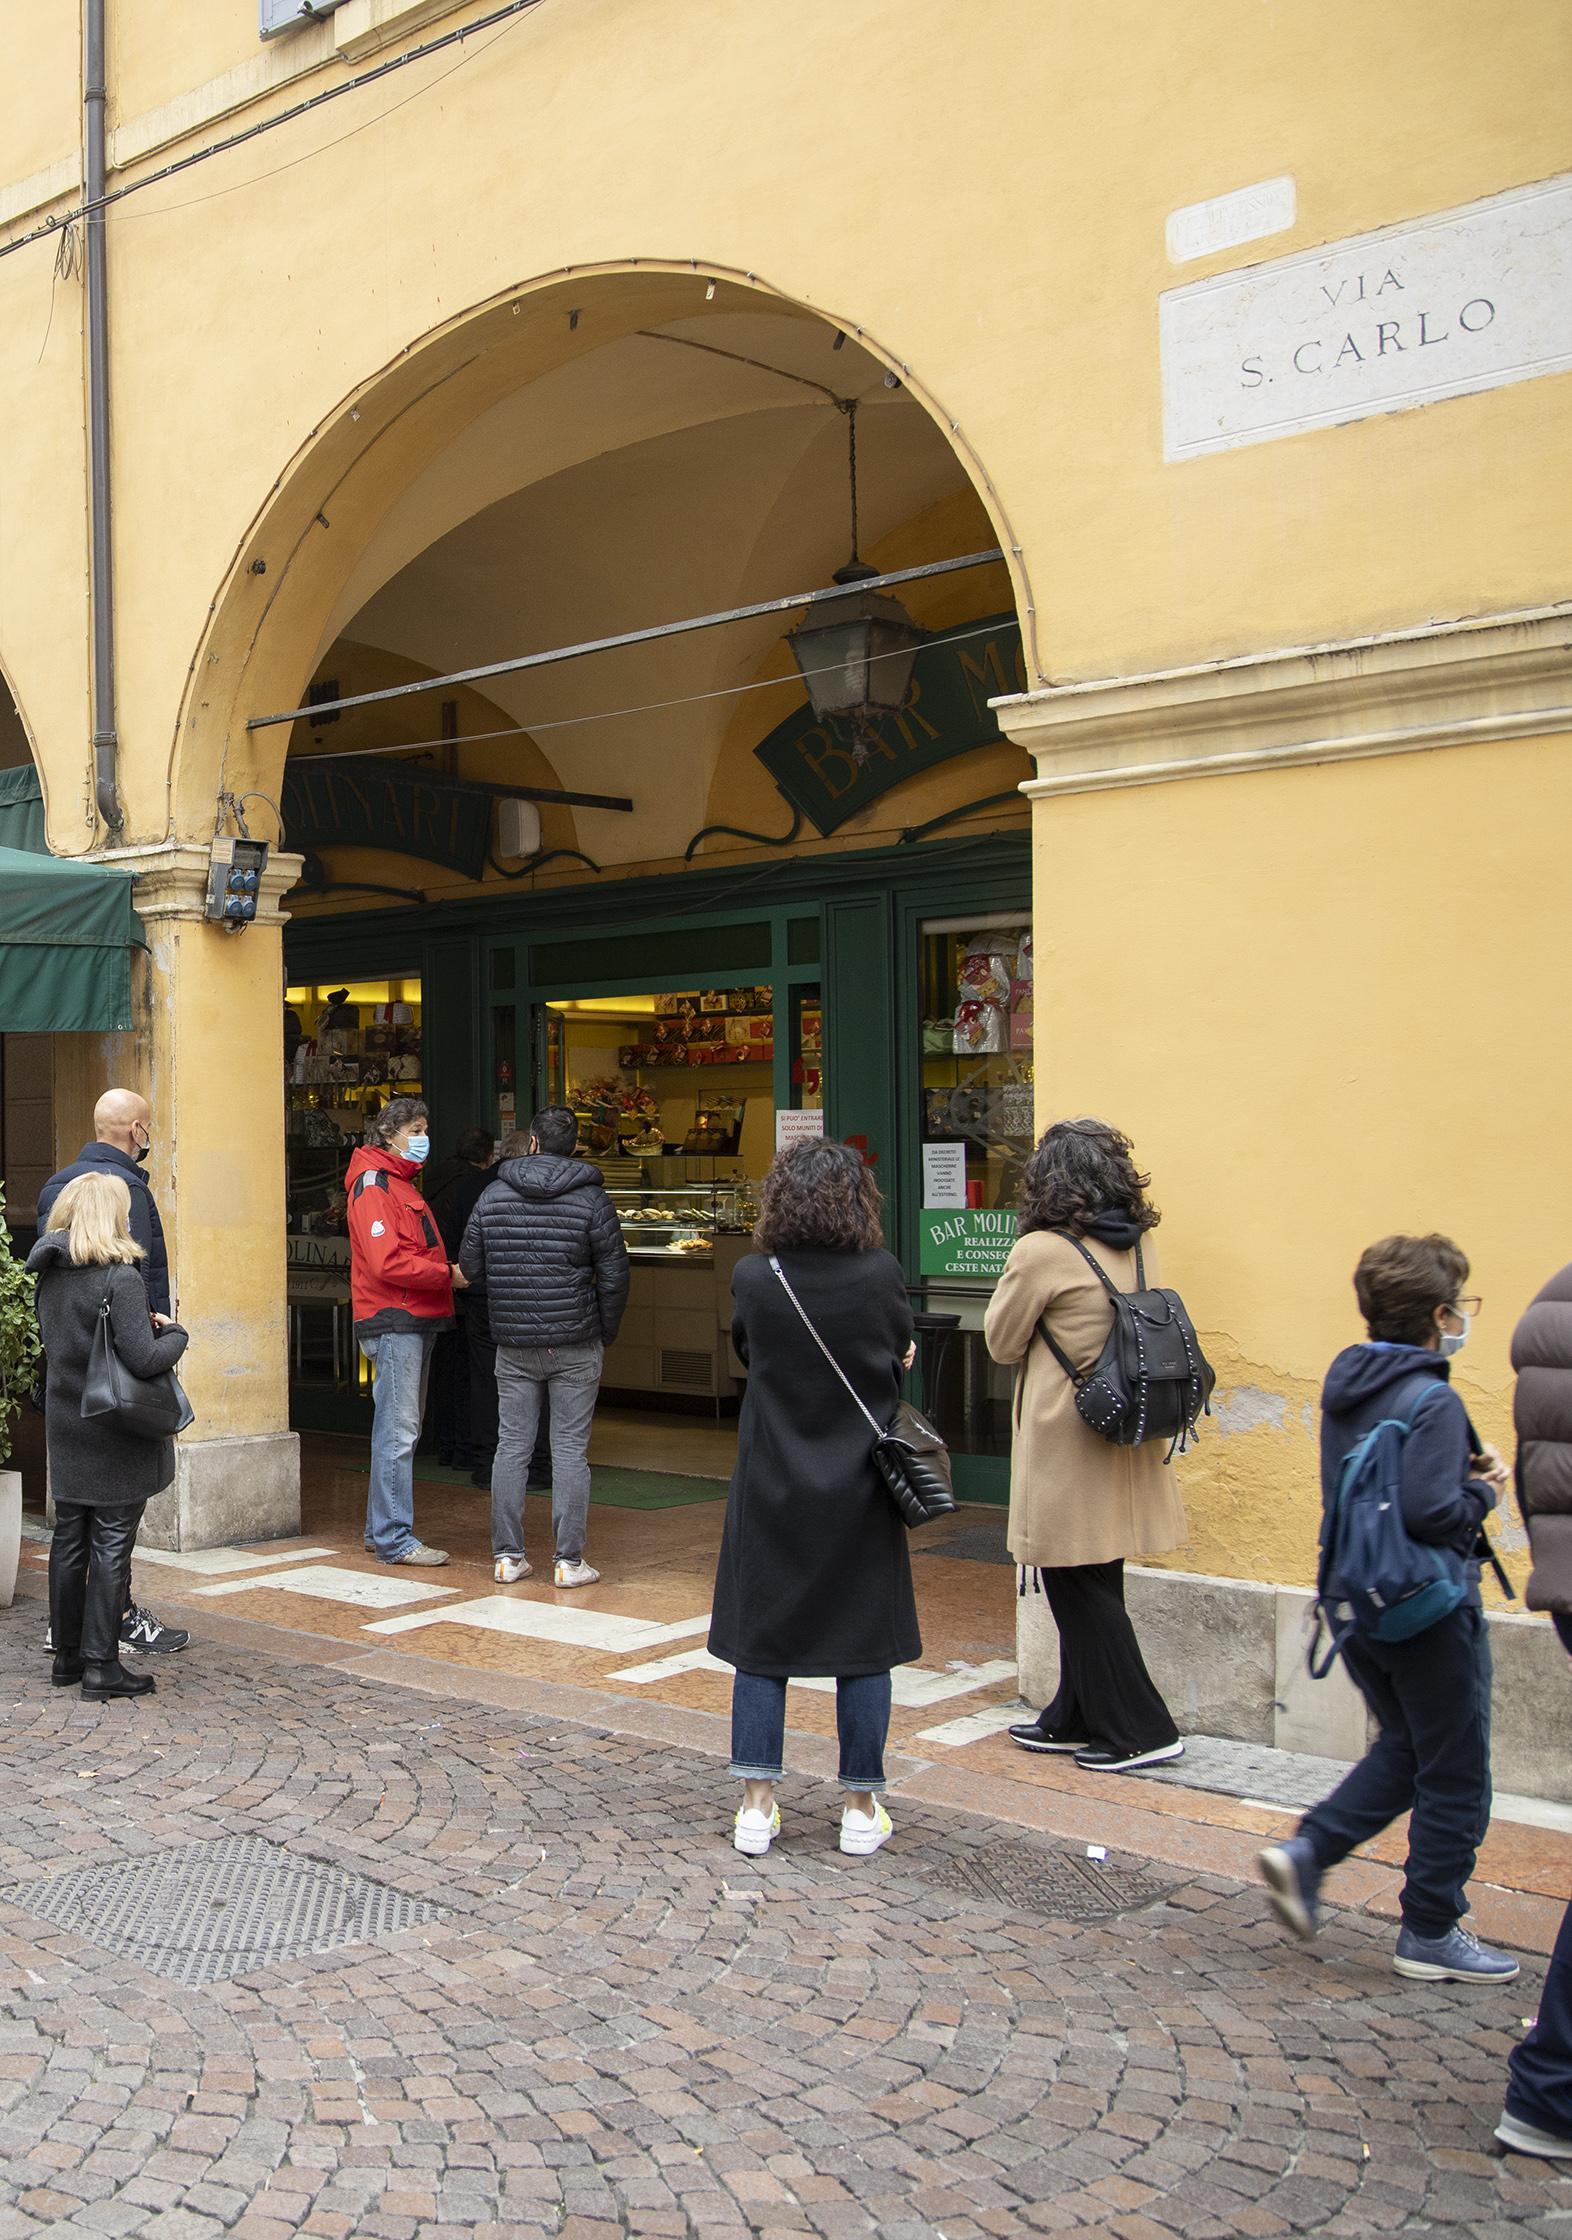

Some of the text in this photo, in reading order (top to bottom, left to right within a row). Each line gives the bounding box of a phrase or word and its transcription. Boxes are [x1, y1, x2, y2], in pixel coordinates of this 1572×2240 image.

[1321, 268, 1405, 306] VIA
[1240, 298, 1496, 389] S. CARLO
[957, 639, 1028, 723] M
[929, 1216, 968, 1246] BAR
[944, 1262, 978, 1272] CESTE
[957, 1250, 964, 1259] E
